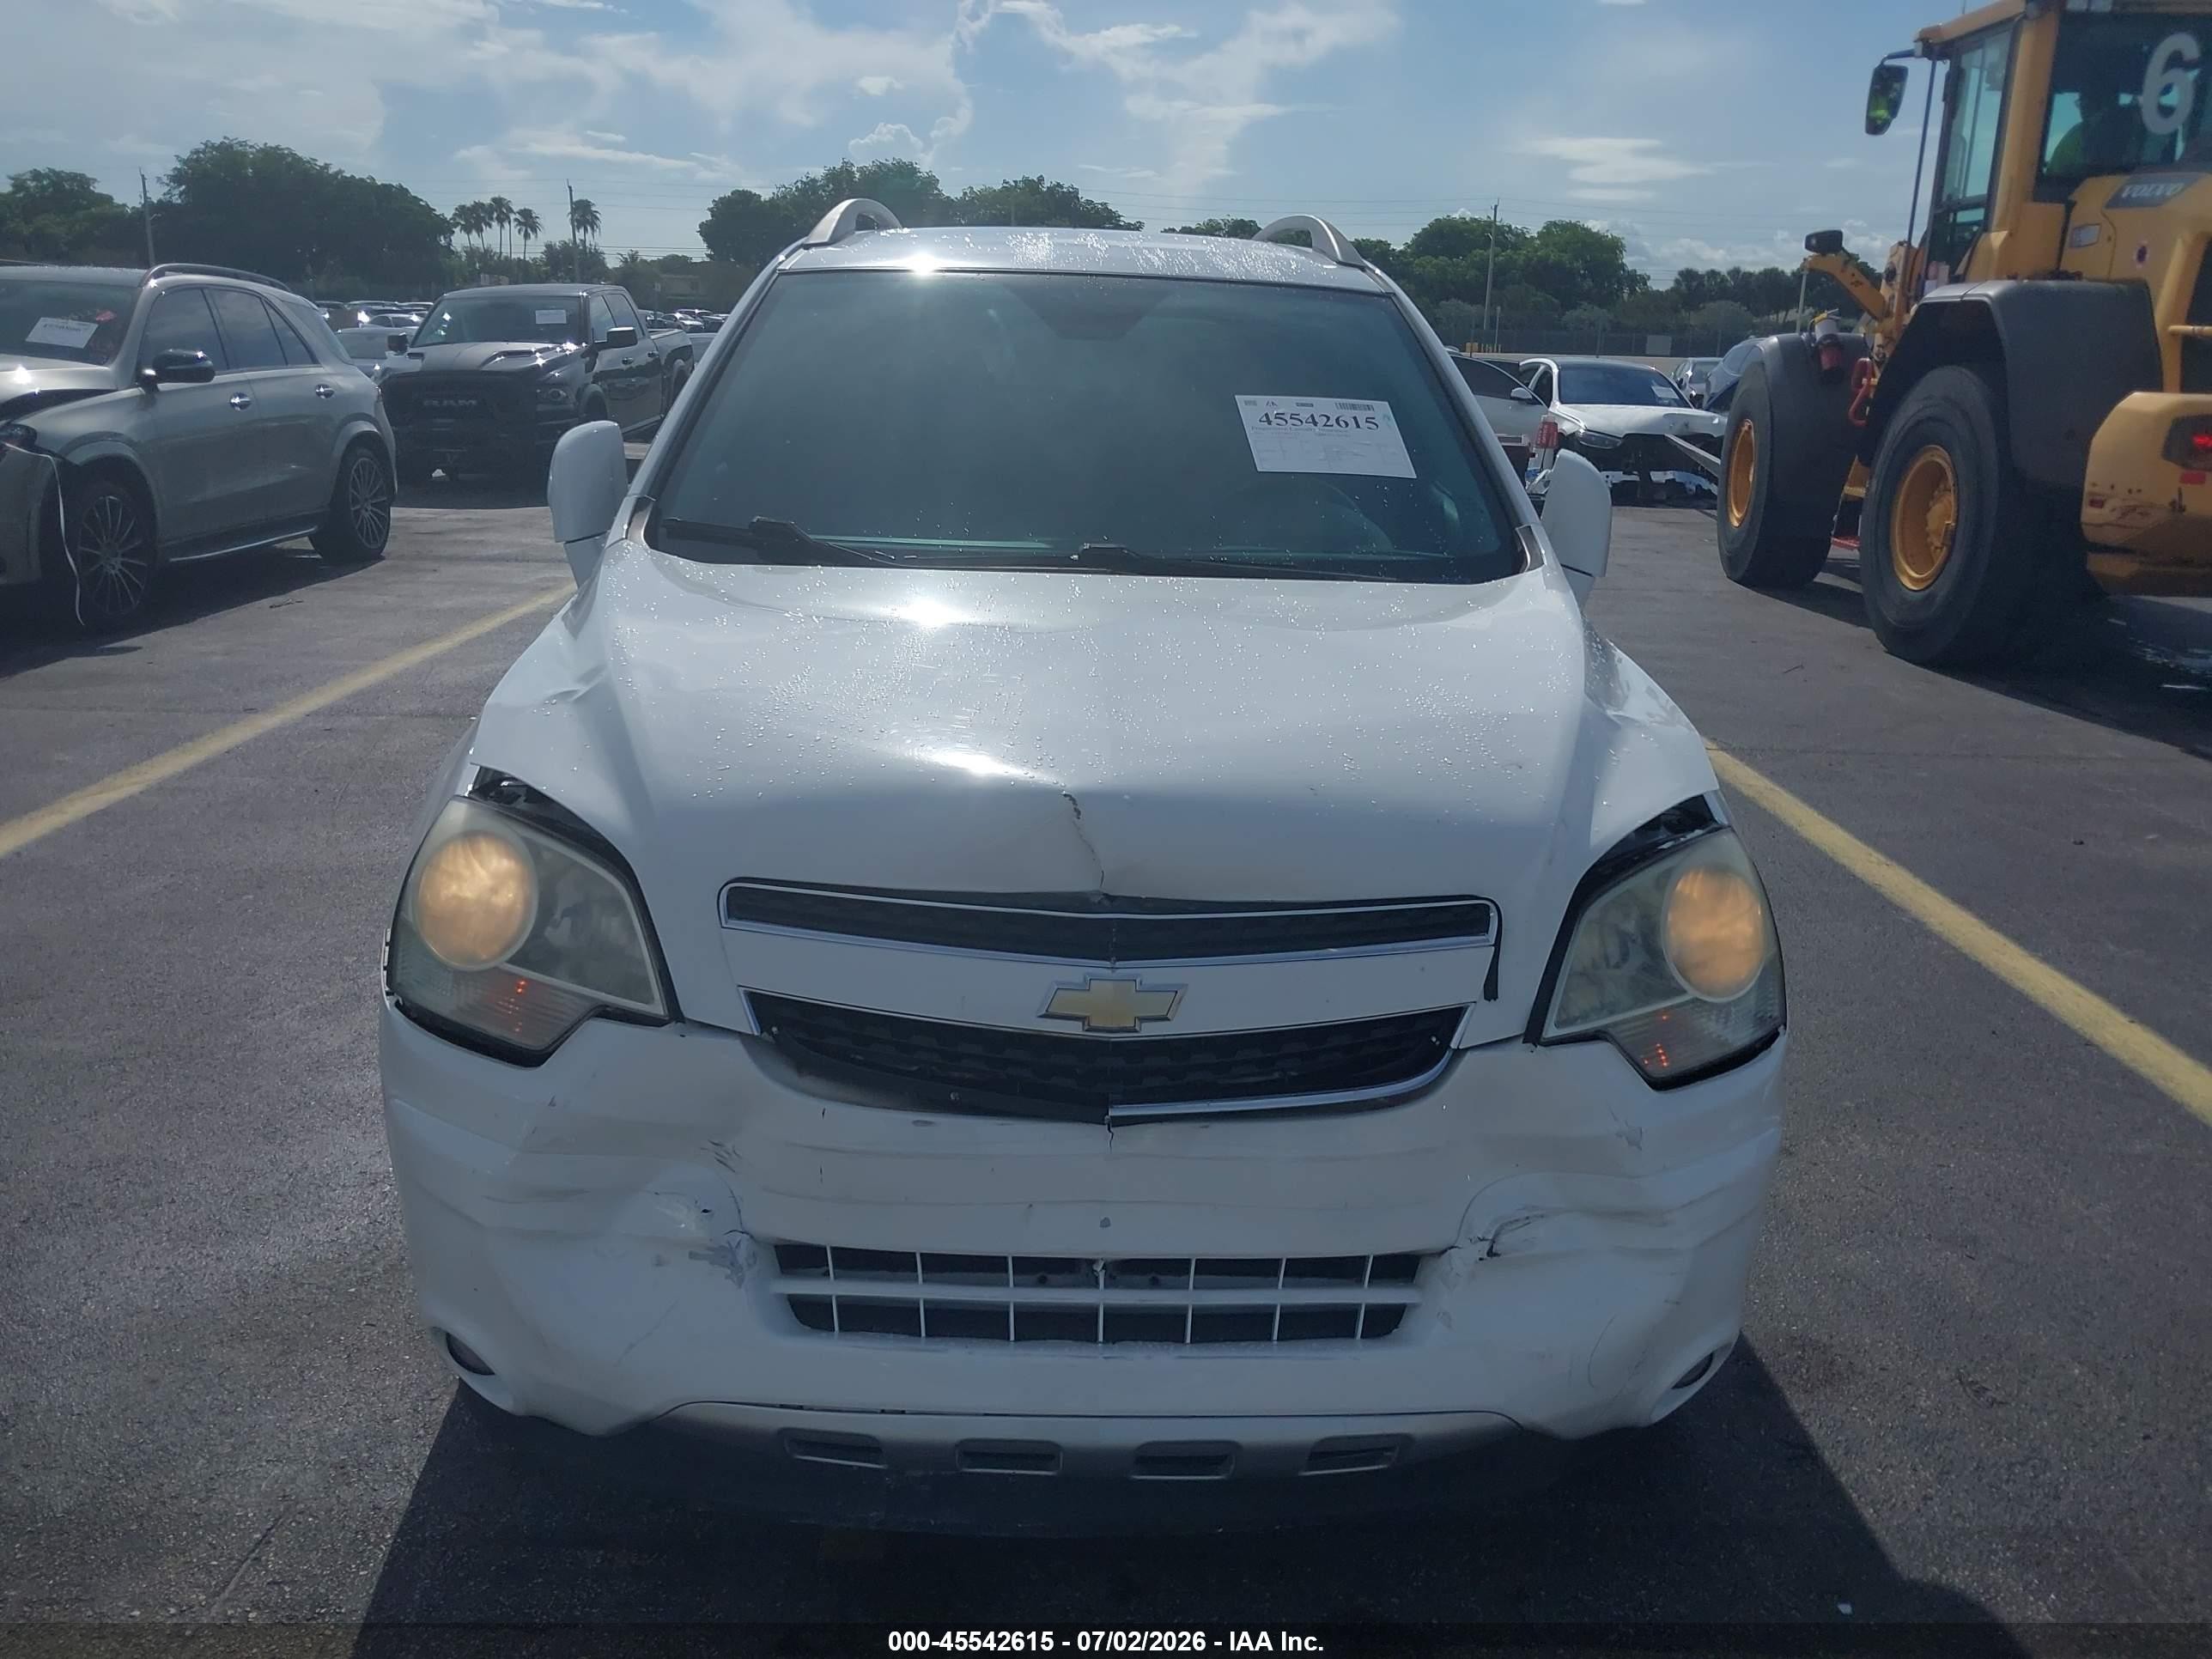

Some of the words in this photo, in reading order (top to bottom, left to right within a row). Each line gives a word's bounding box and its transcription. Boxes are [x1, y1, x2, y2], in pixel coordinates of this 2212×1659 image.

[2141, 32, 2202, 137] 6
[423, 398, 477, 407] RAM
[1258, 411, 1380, 431] 45542615
